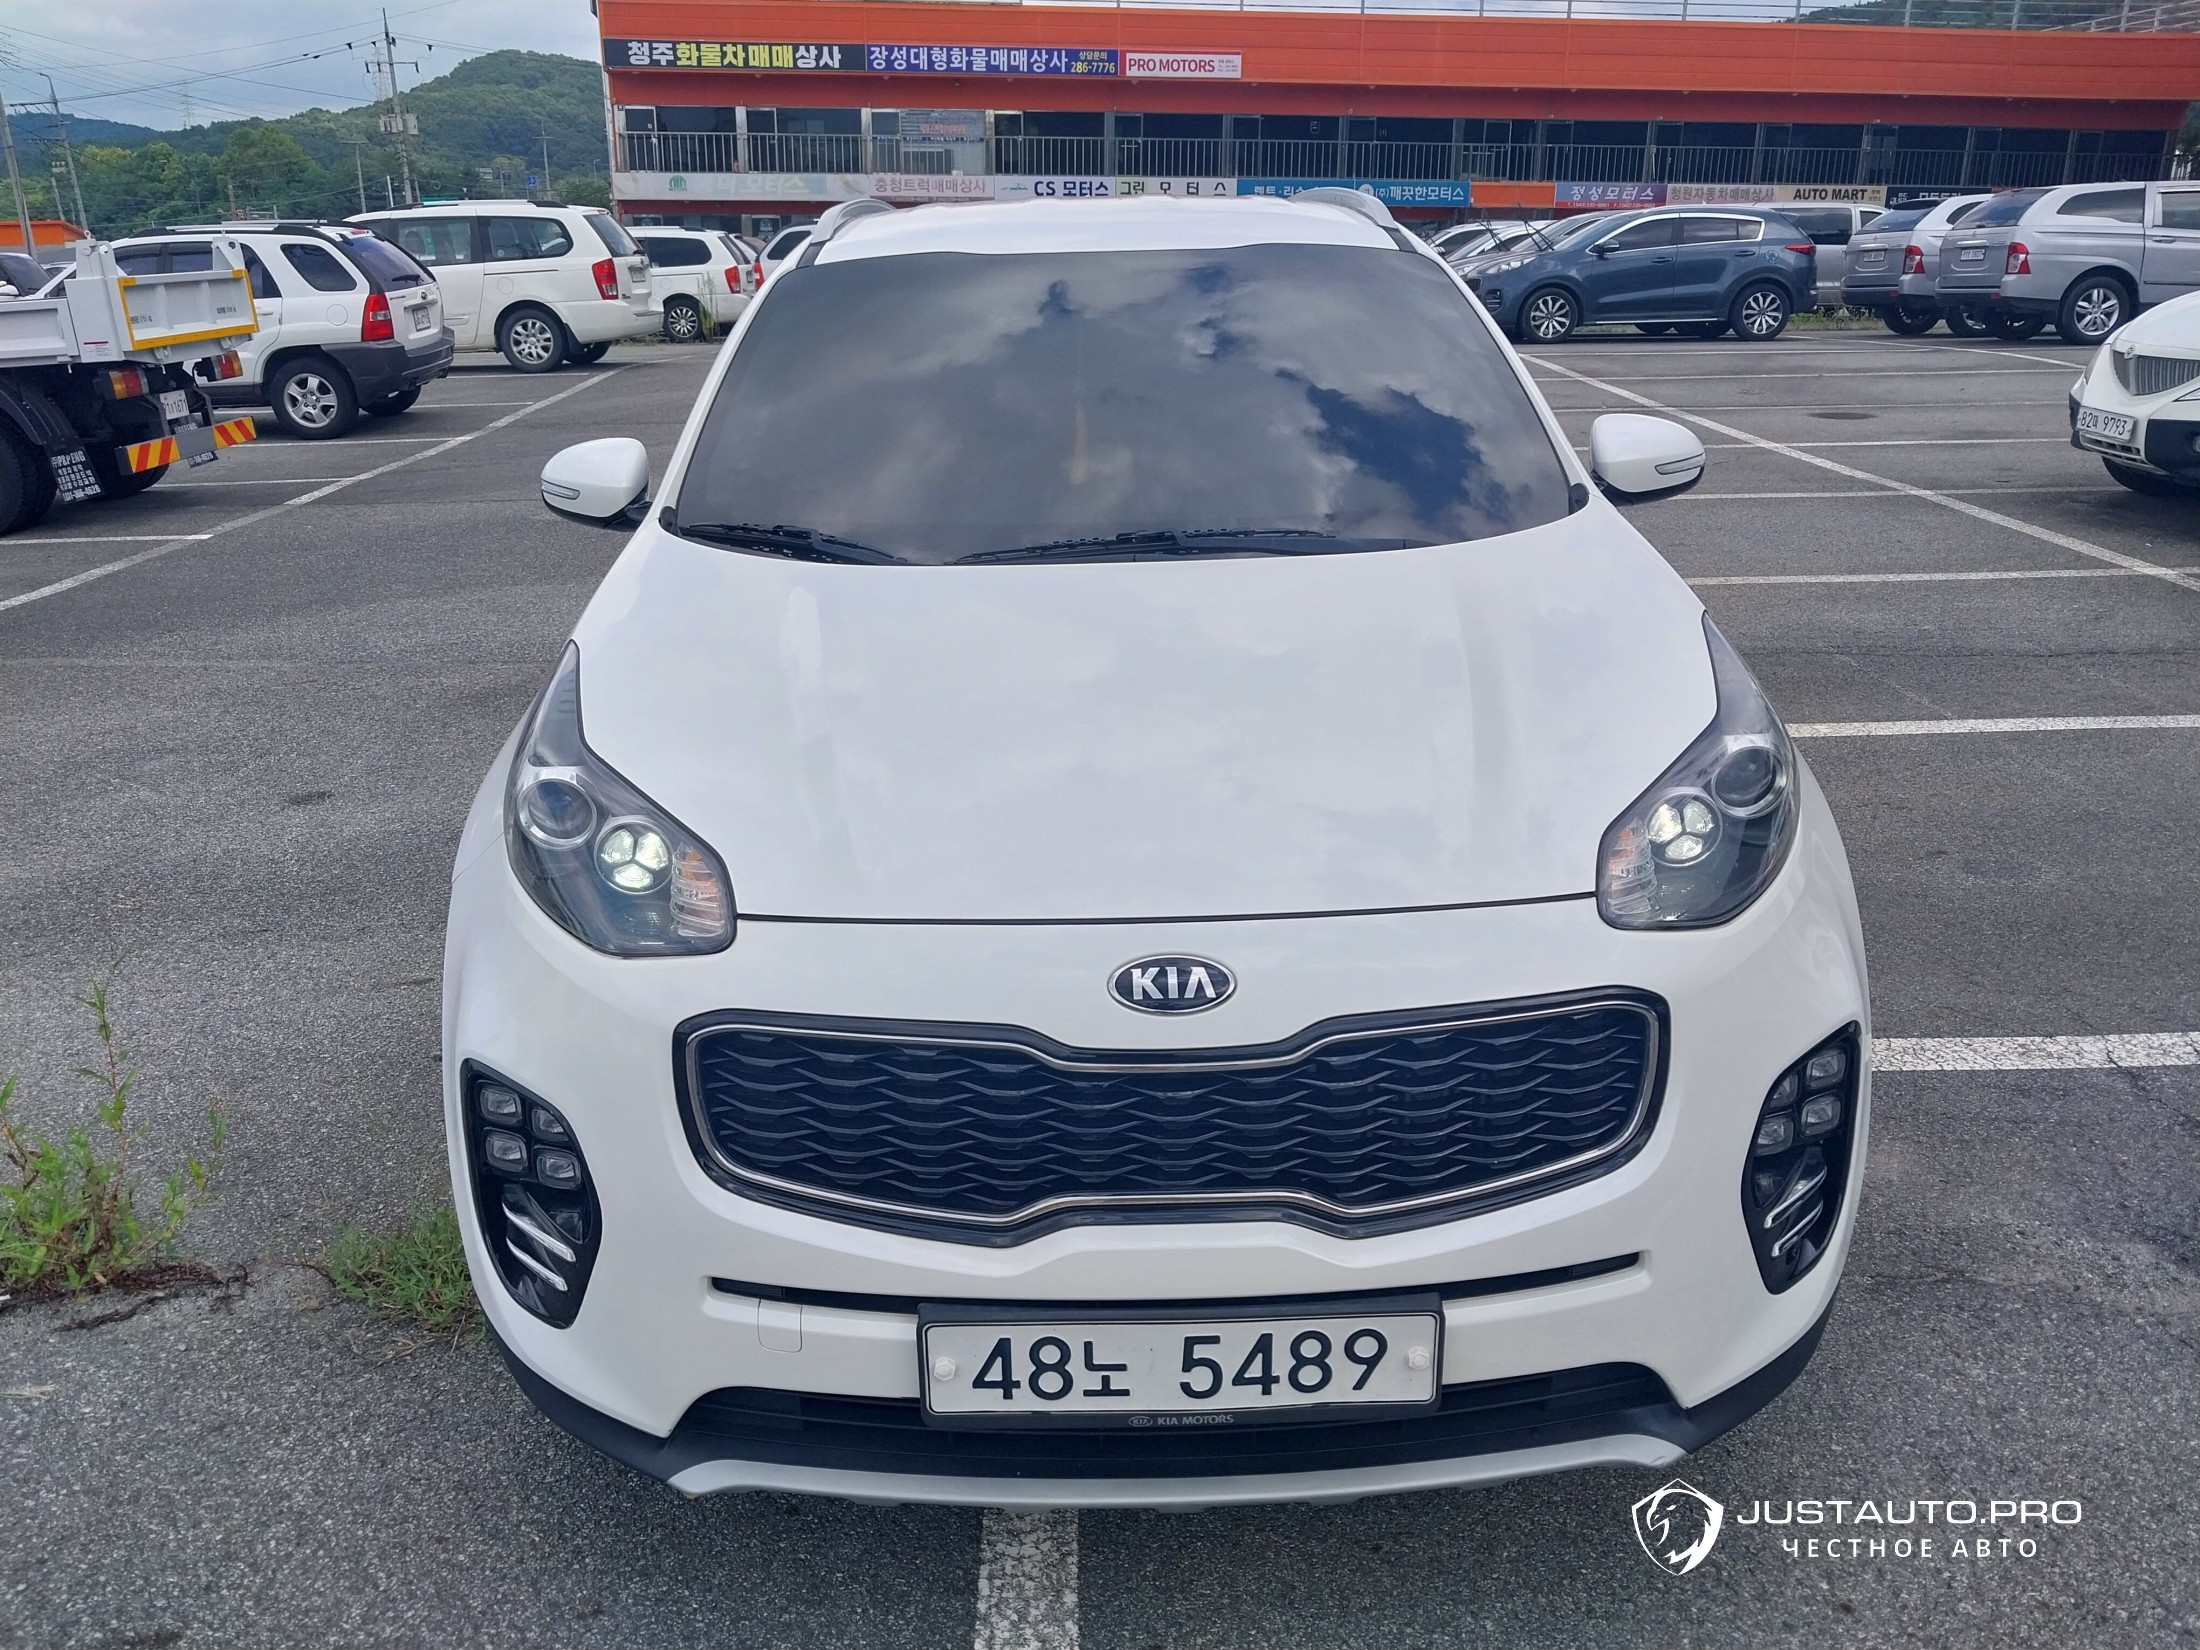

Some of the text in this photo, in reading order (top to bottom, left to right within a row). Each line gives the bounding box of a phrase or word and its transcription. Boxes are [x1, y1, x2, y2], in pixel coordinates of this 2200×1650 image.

[627, 41, 841, 69] 청주화물차매매상사
[869, 46, 1068, 74] 장성대형화물매매상사
[1079, 51, 1108, 60] 상담문의
[1071, 61, 1116, 74] 286-7776
[1128, 58, 1157, 72] PRO
[1159, 59, 1215, 73] MOTORS
[1034, 181, 1109, 197] CS 모터스
[1120, 181, 1145, 194] 그린
[1570, 186, 1654, 201] 정성모터스
[1793, 188, 1829, 201] AUTO
[1831, 188, 1868, 201] MART
[2103, 416, 2128, 436] 9793
[1130, 966, 1216, 1000] KIA
[971, 1328, 1389, 1400] 48노 5489
[1157, 1416, 1179, 1426] KIA
[1181, 1413, 1235, 1425] MOTORS
